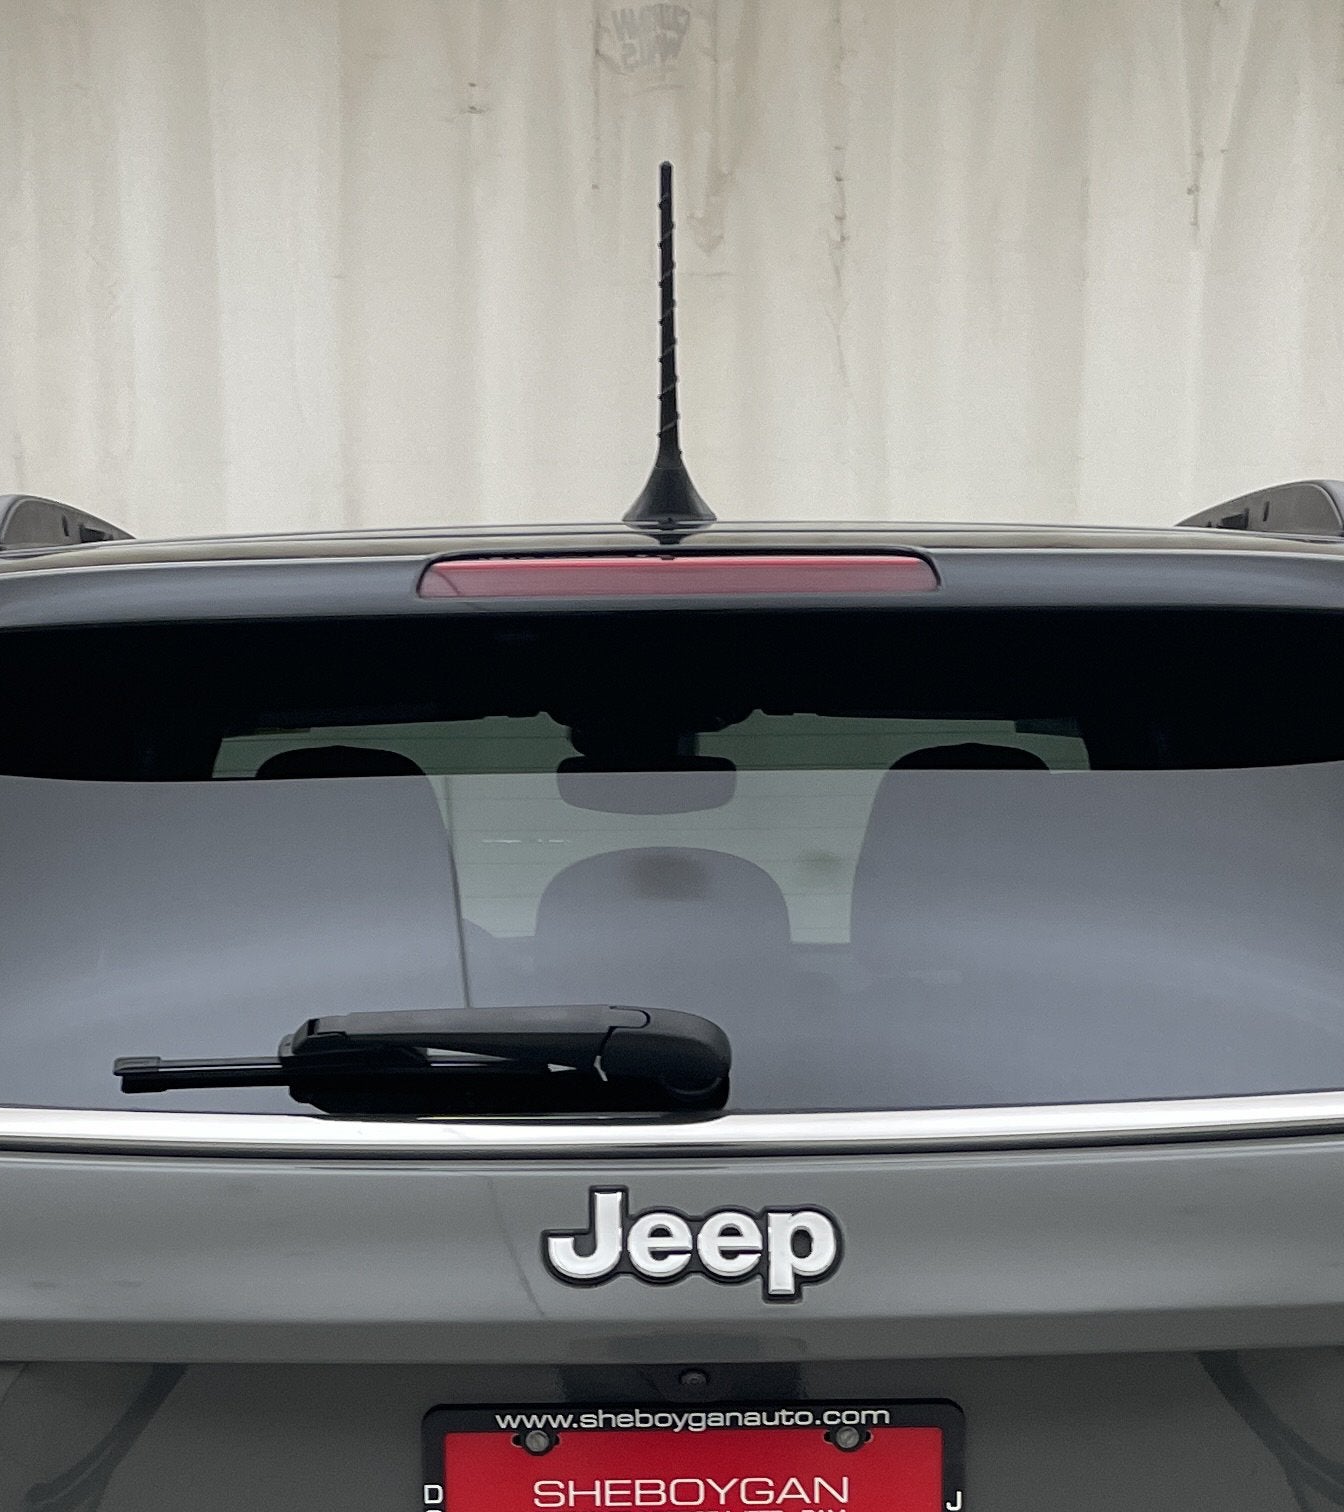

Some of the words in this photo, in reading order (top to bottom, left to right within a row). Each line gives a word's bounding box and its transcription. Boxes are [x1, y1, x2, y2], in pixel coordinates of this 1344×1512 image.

[548, 1191, 837, 1295] Jeep
[496, 1408, 890, 1431] www.sheboyganauto.com
[533, 1477, 849, 1507] SHEBOYGAN
